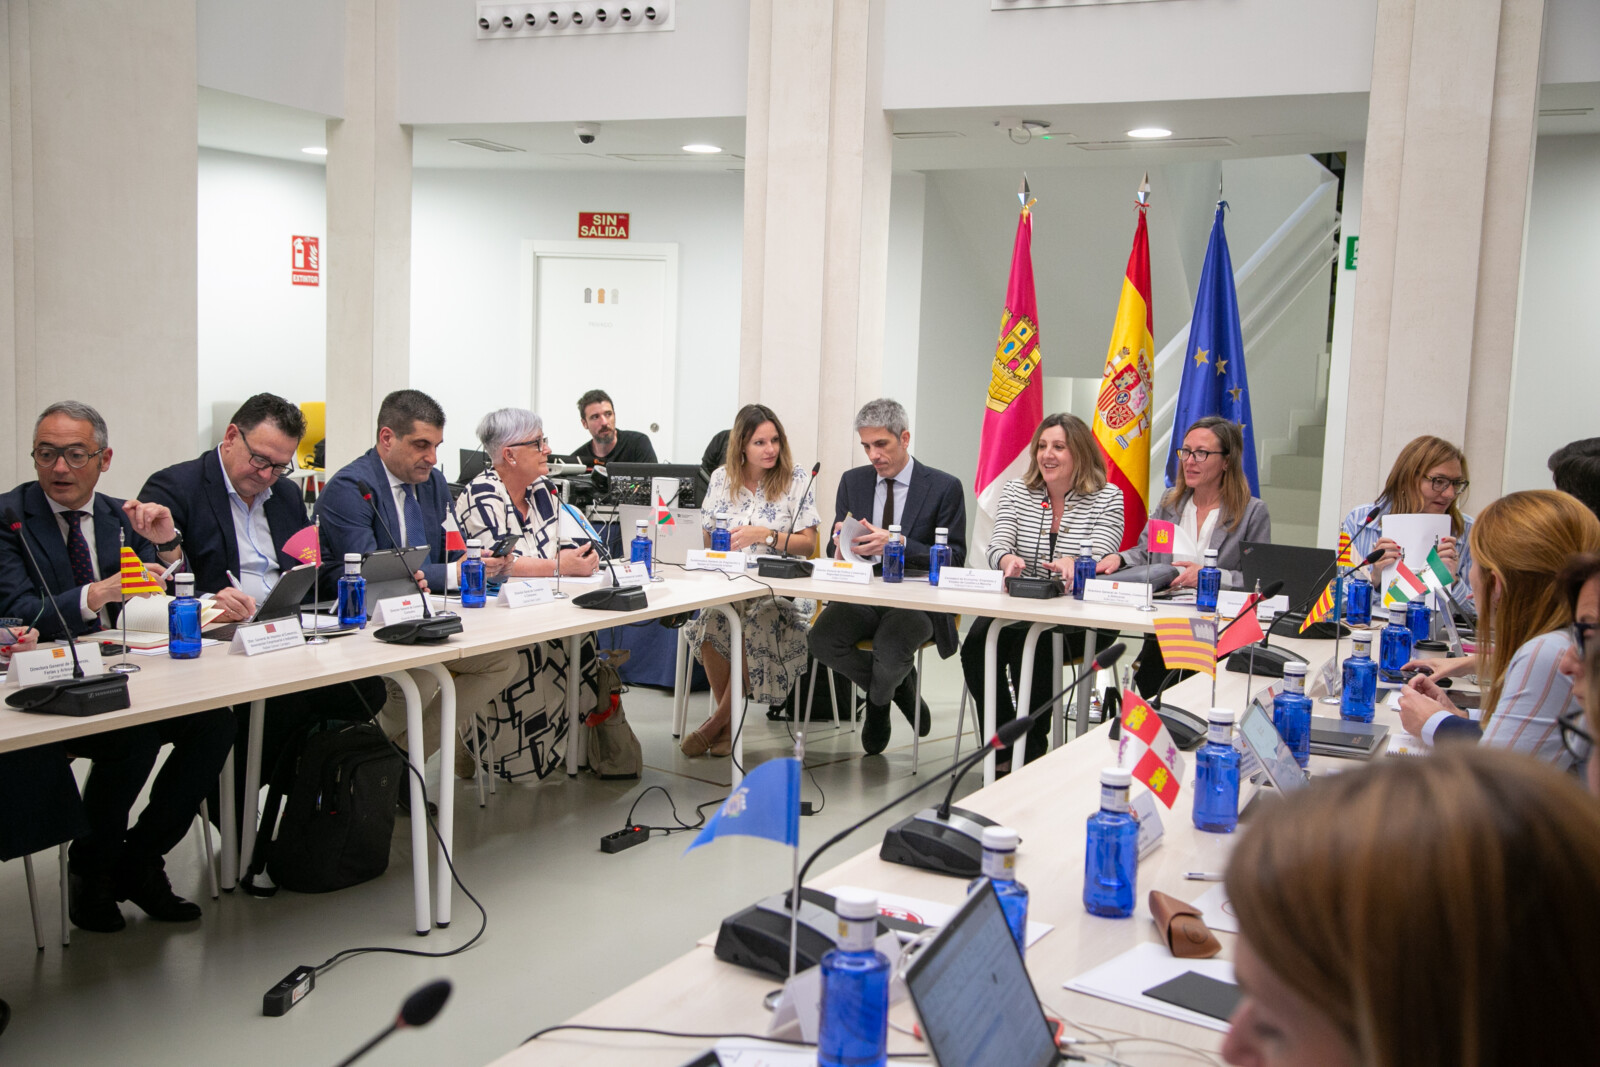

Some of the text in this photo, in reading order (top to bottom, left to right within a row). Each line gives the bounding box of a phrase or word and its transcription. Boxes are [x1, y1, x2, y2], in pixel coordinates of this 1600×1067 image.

[593, 214, 617, 225] SIN
[580, 225, 627, 237] SALIDA
[292, 275, 318, 283] EXTINTOR
